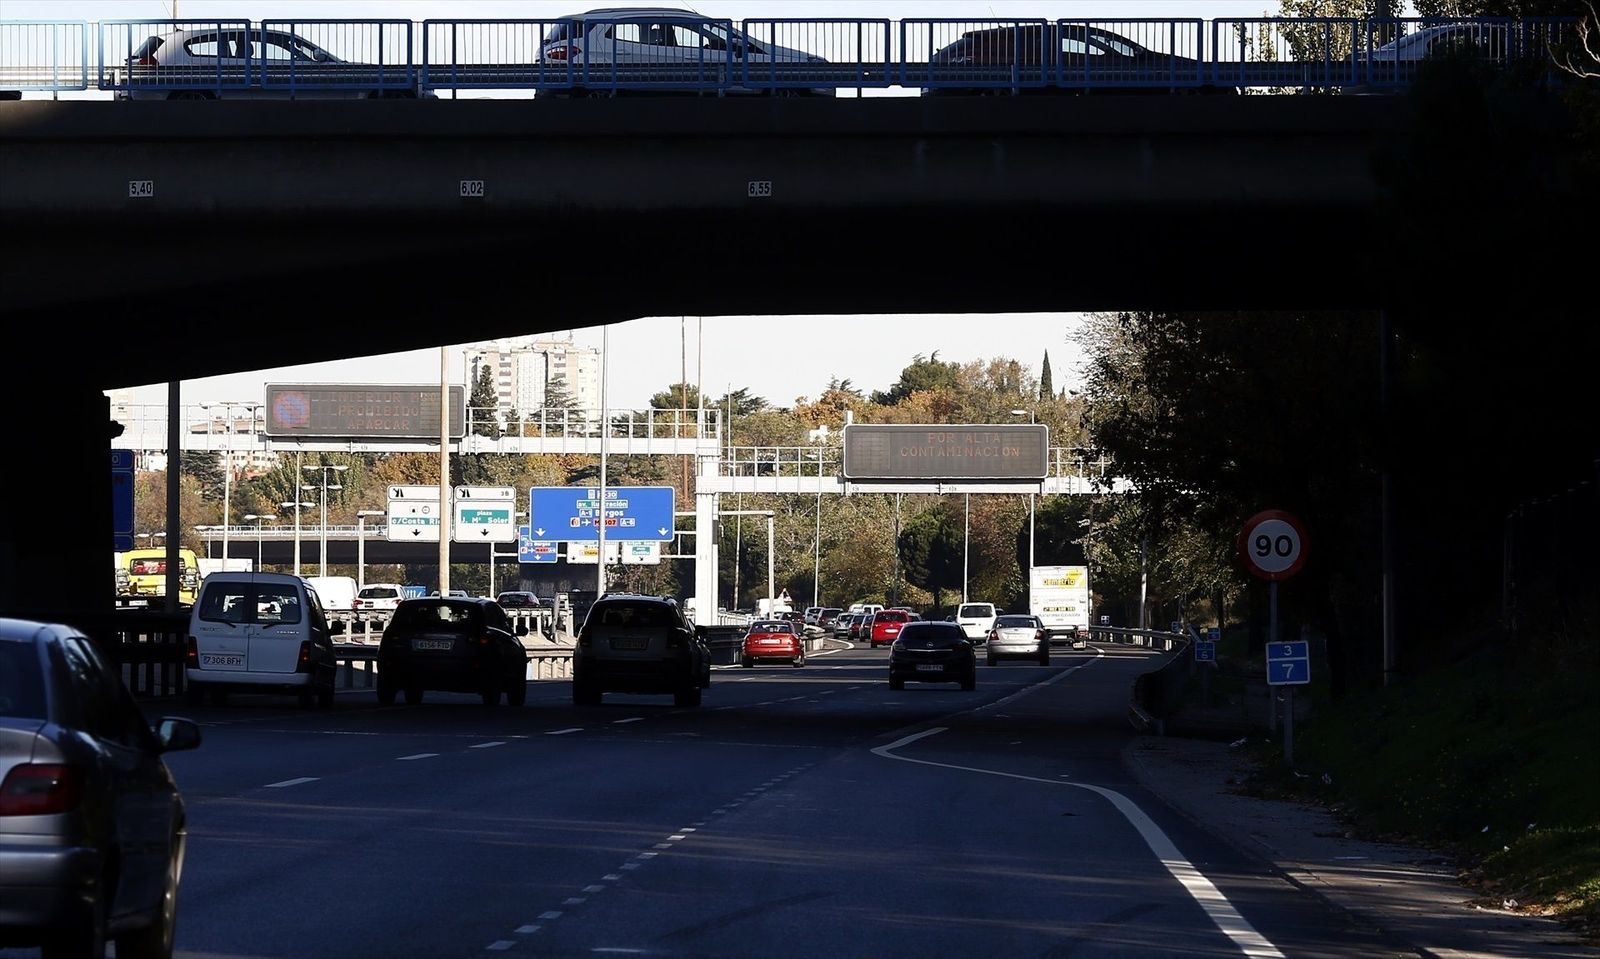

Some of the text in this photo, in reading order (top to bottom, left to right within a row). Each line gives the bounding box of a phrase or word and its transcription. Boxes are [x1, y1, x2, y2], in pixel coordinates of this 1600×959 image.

[131, 182, 152, 195] 5,40
[462, 182, 482, 195] 6,02
[749, 182, 770, 195] 6,55
[347, 418, 410, 430] APARCAR
[928, 432, 1001, 444] POR ALTA
[900, 446, 1021, 458] CONTAMINACION
[595, 509, 624, 518] Brgos
[1255, 534, 1293, 557] 90
[1282, 645, 1293, 657] 3
[1281, 663, 1295, 679] 7
